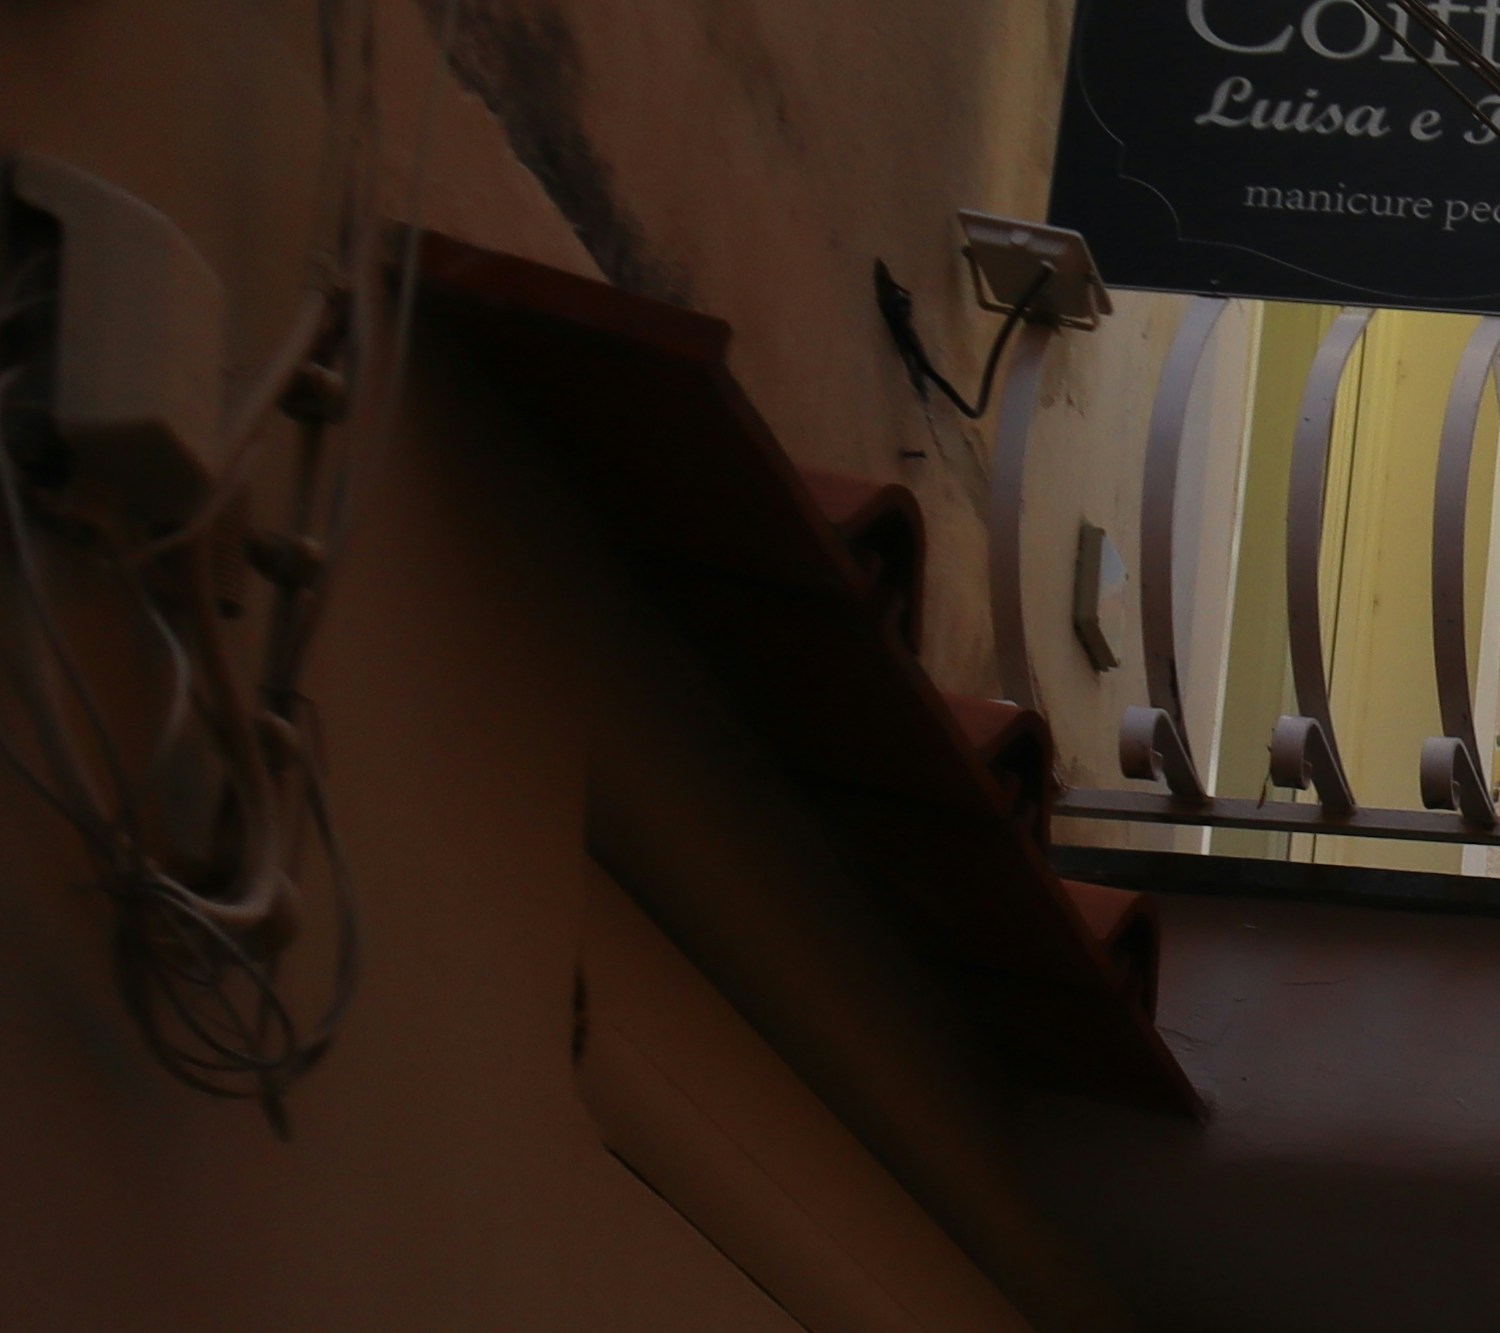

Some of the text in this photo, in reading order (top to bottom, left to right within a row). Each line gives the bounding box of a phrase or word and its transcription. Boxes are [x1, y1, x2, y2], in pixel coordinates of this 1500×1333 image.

[1195, 76, 1391, 138] Luisa
[1409, 109, 1443, 141] e
[1244, 182, 1433, 219] manicure
